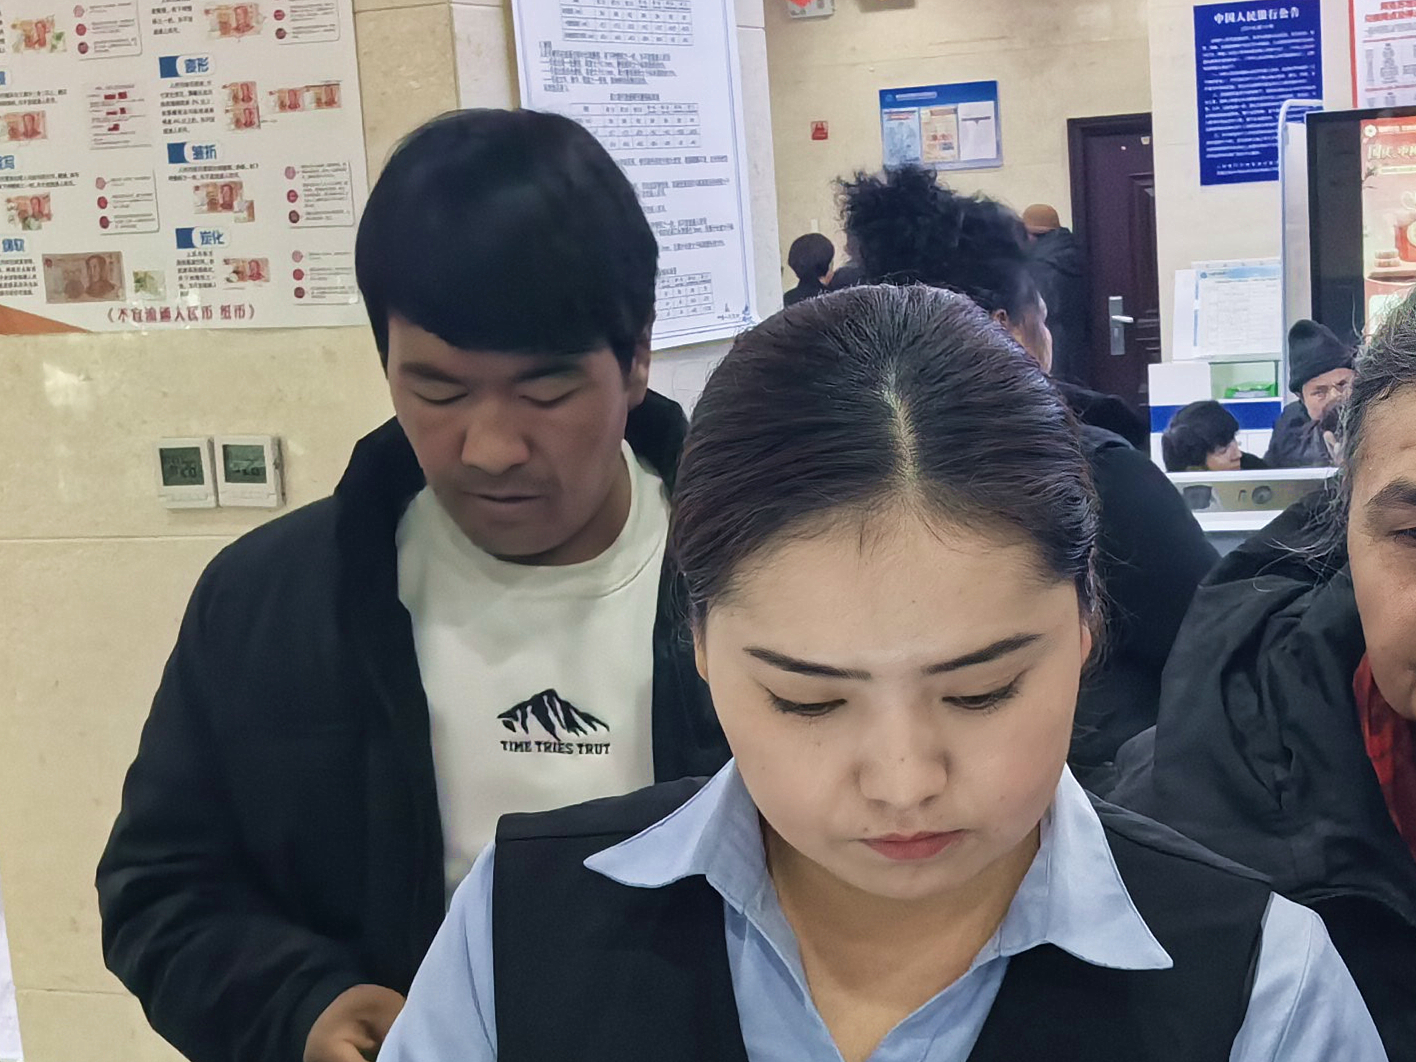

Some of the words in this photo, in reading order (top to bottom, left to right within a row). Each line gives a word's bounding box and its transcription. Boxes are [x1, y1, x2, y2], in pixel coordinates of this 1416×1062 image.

[500, 740, 532, 753] TIME
[534, 740, 574, 755] TRIES
[575, 742, 611, 755] TRUT
